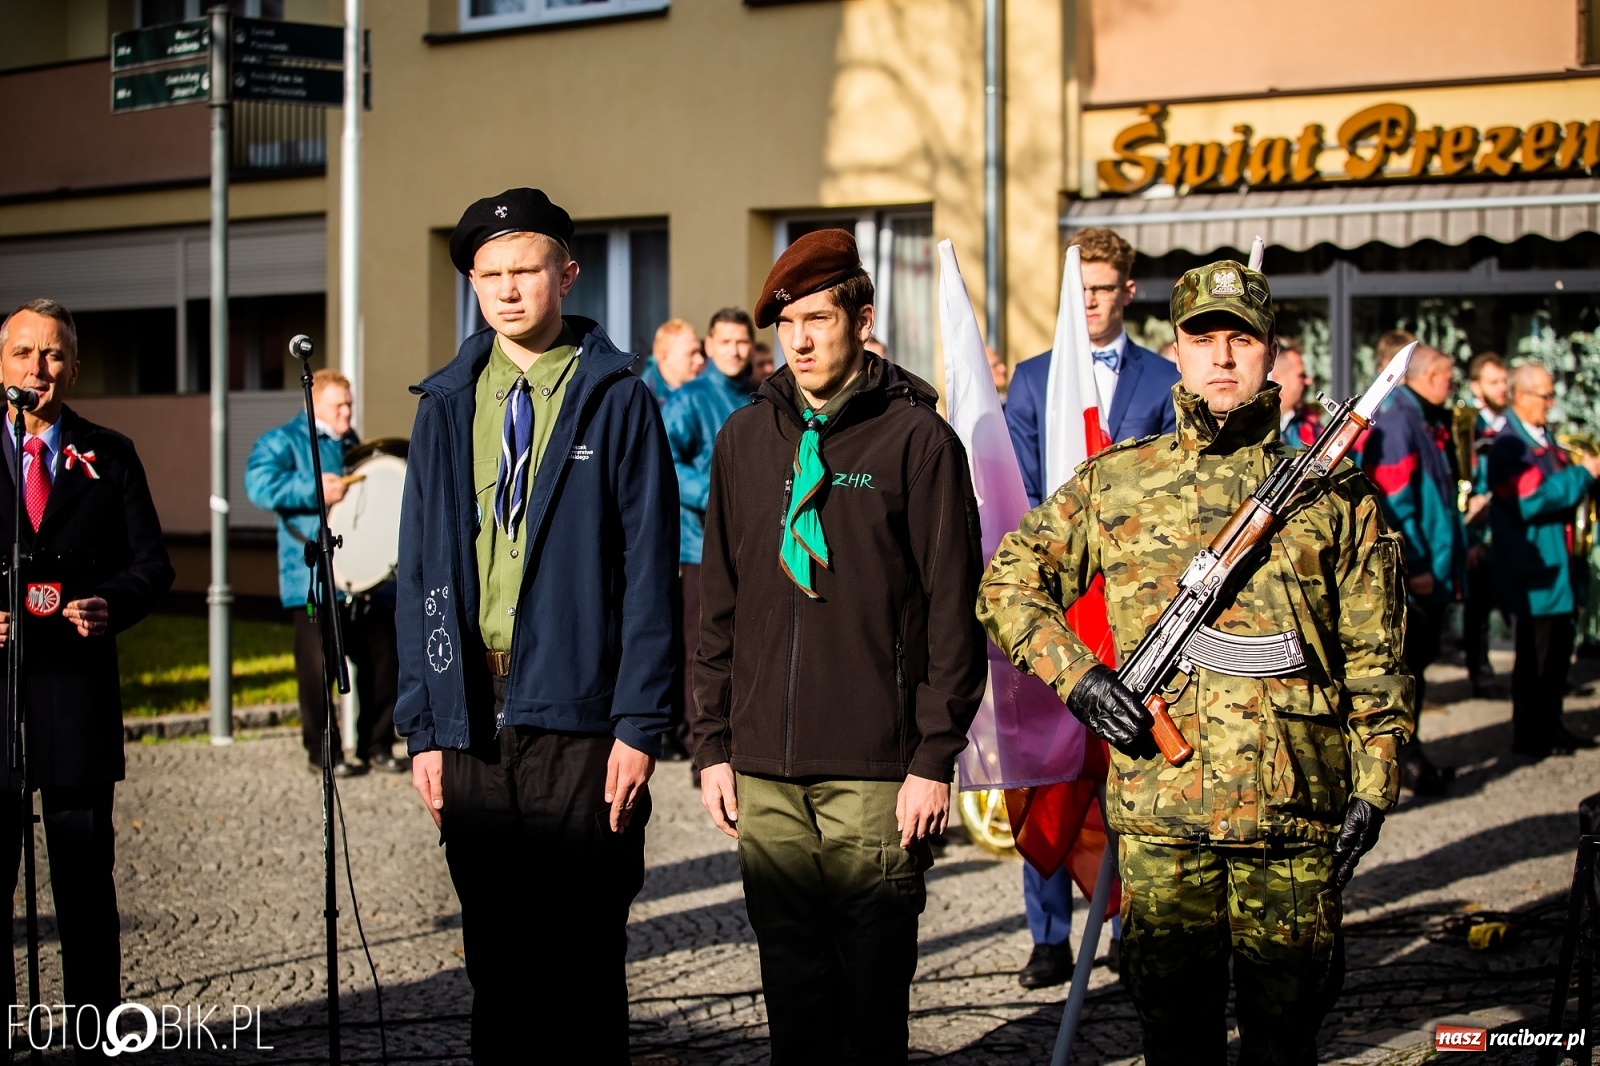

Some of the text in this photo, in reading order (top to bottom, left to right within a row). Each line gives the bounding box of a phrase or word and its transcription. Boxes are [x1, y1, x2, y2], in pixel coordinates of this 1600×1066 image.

[1098, 102, 1600, 193] Świat Prezen
[831, 472, 876, 490] ZHR
